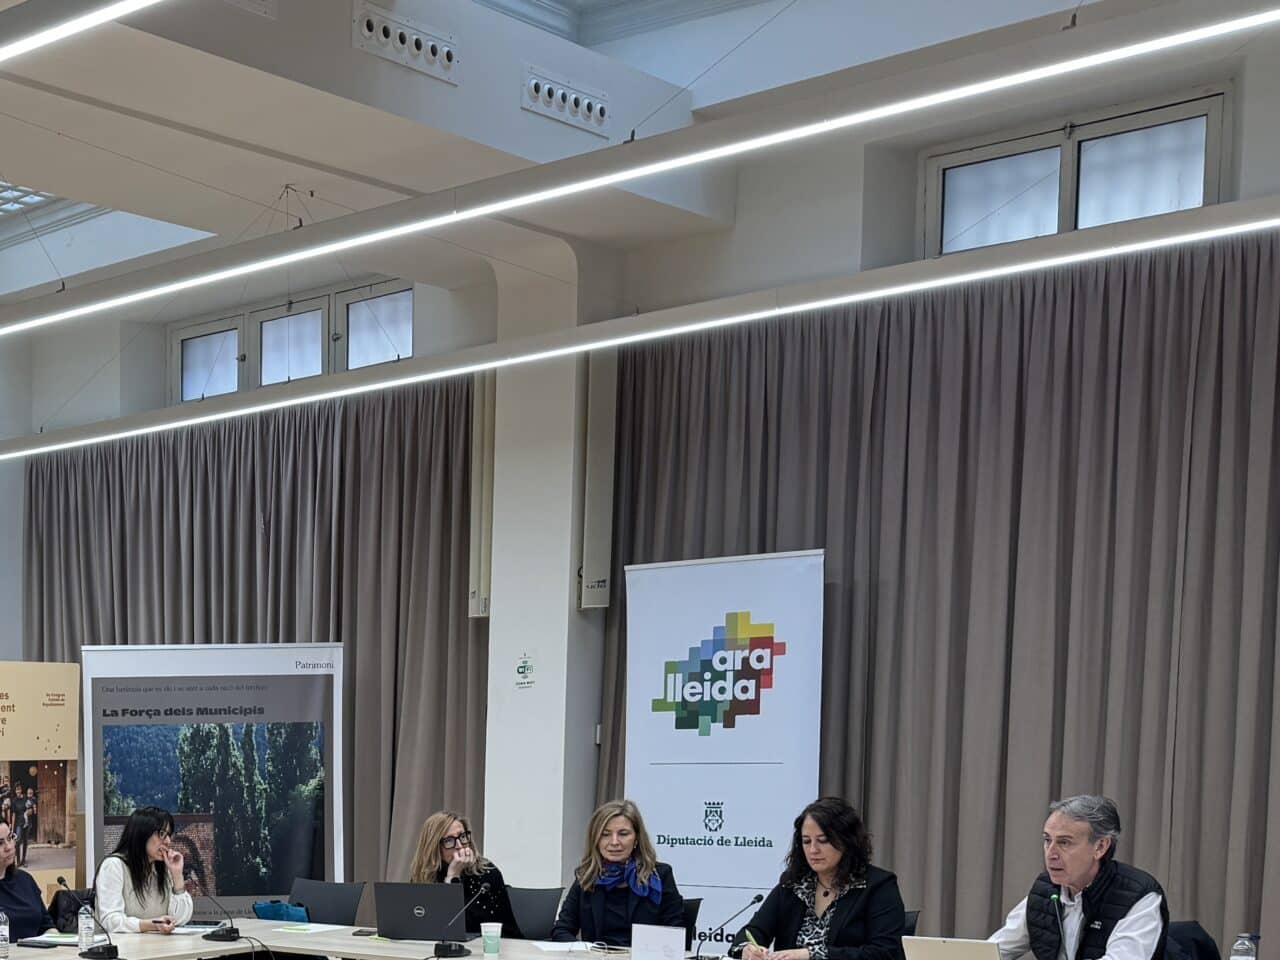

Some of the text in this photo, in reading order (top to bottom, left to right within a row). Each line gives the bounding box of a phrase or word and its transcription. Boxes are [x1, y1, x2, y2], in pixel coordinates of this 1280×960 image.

[295, 660, 334, 670] Patrimoni
[712, 647, 772, 671] ara
[666, 672, 757, 703] lleida
[102, 706, 265, 720] La Força dels Municipis
[656, 834, 774, 849] Diputació de Lleida
